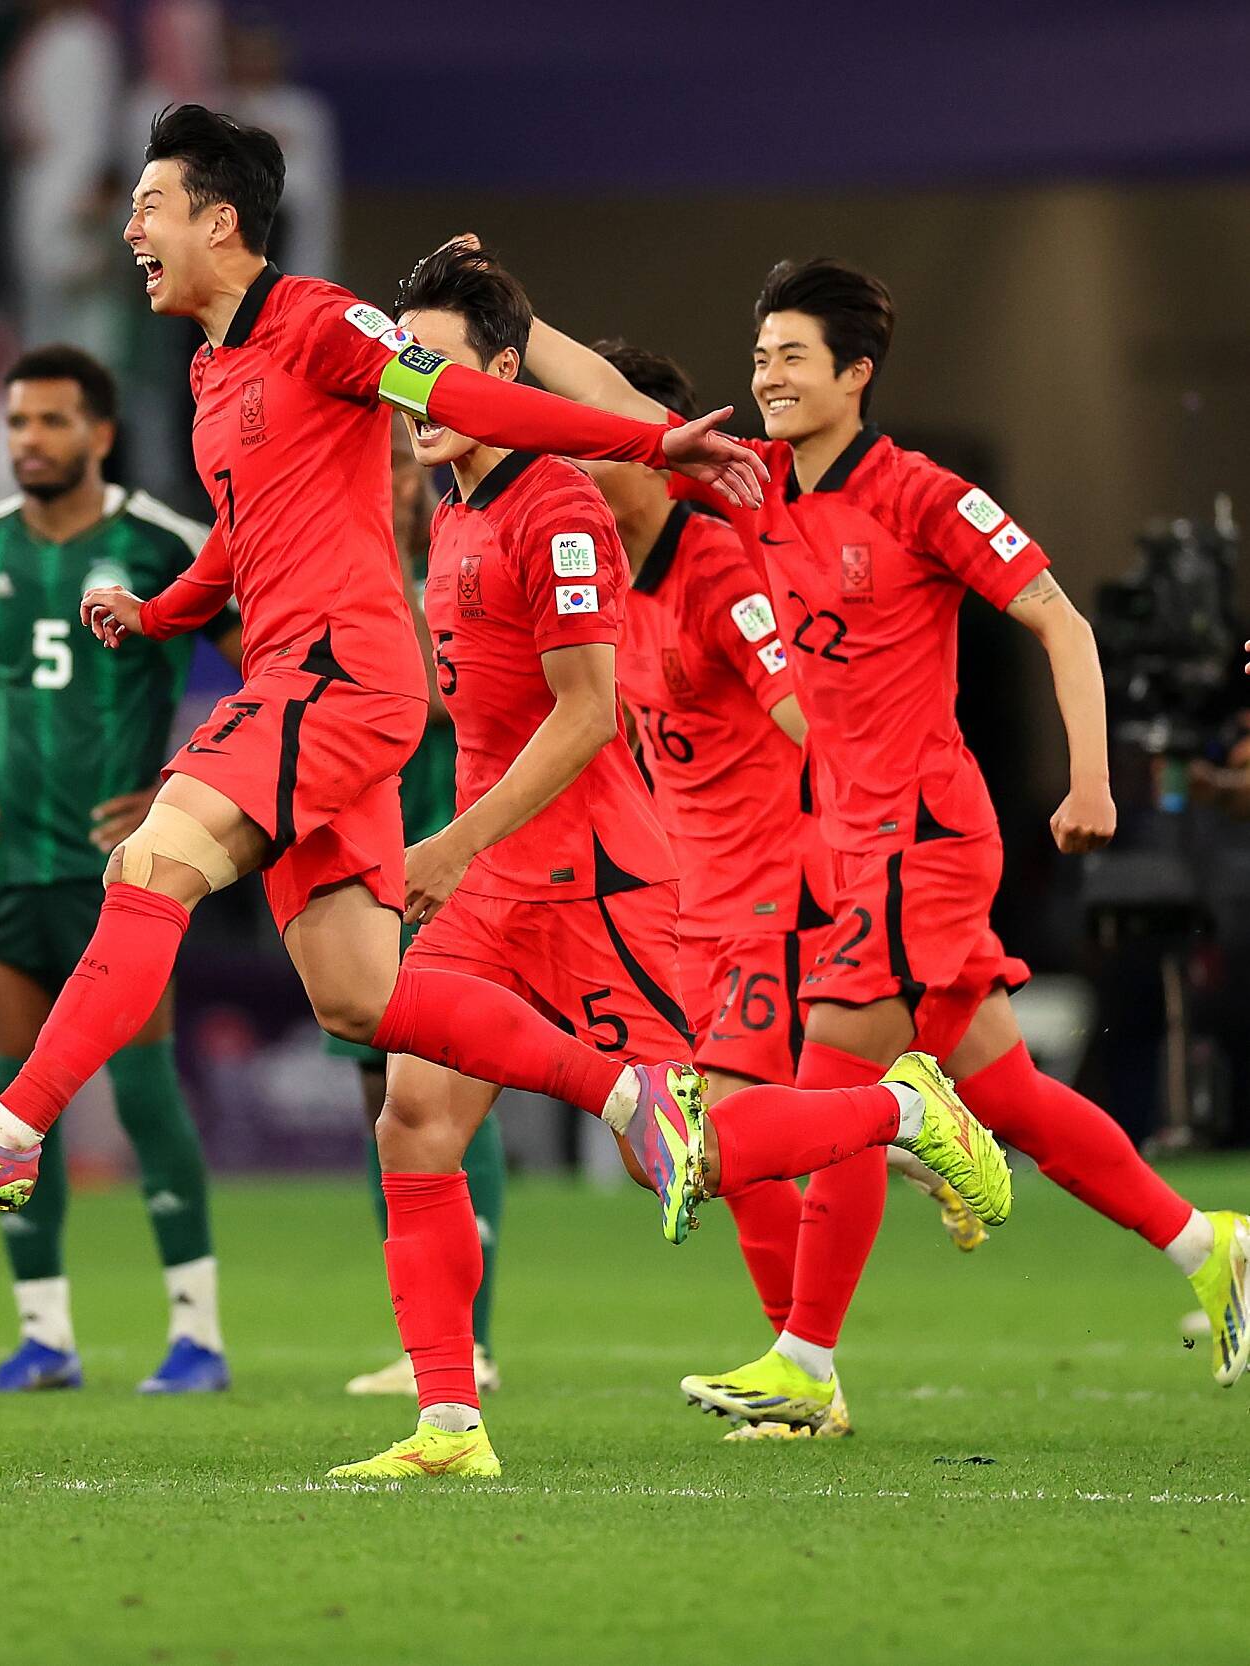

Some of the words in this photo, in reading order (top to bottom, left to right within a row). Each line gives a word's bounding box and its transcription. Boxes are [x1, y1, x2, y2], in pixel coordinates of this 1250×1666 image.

[353, 308, 367, 319] AFC
[241, 433, 267, 446] KOREA
[214, 469, 235, 533] 7
[559, 549, 589, 560] LIVE
[32, 618, 74, 690] 5
[788, 591, 848, 664] 22
[437, 632, 457, 695] 5
[211, 702, 264, 743] 7
[640, 706, 694, 763] 16
[581, 988, 628, 1052] 5
[717, 966, 779, 1031] 16
